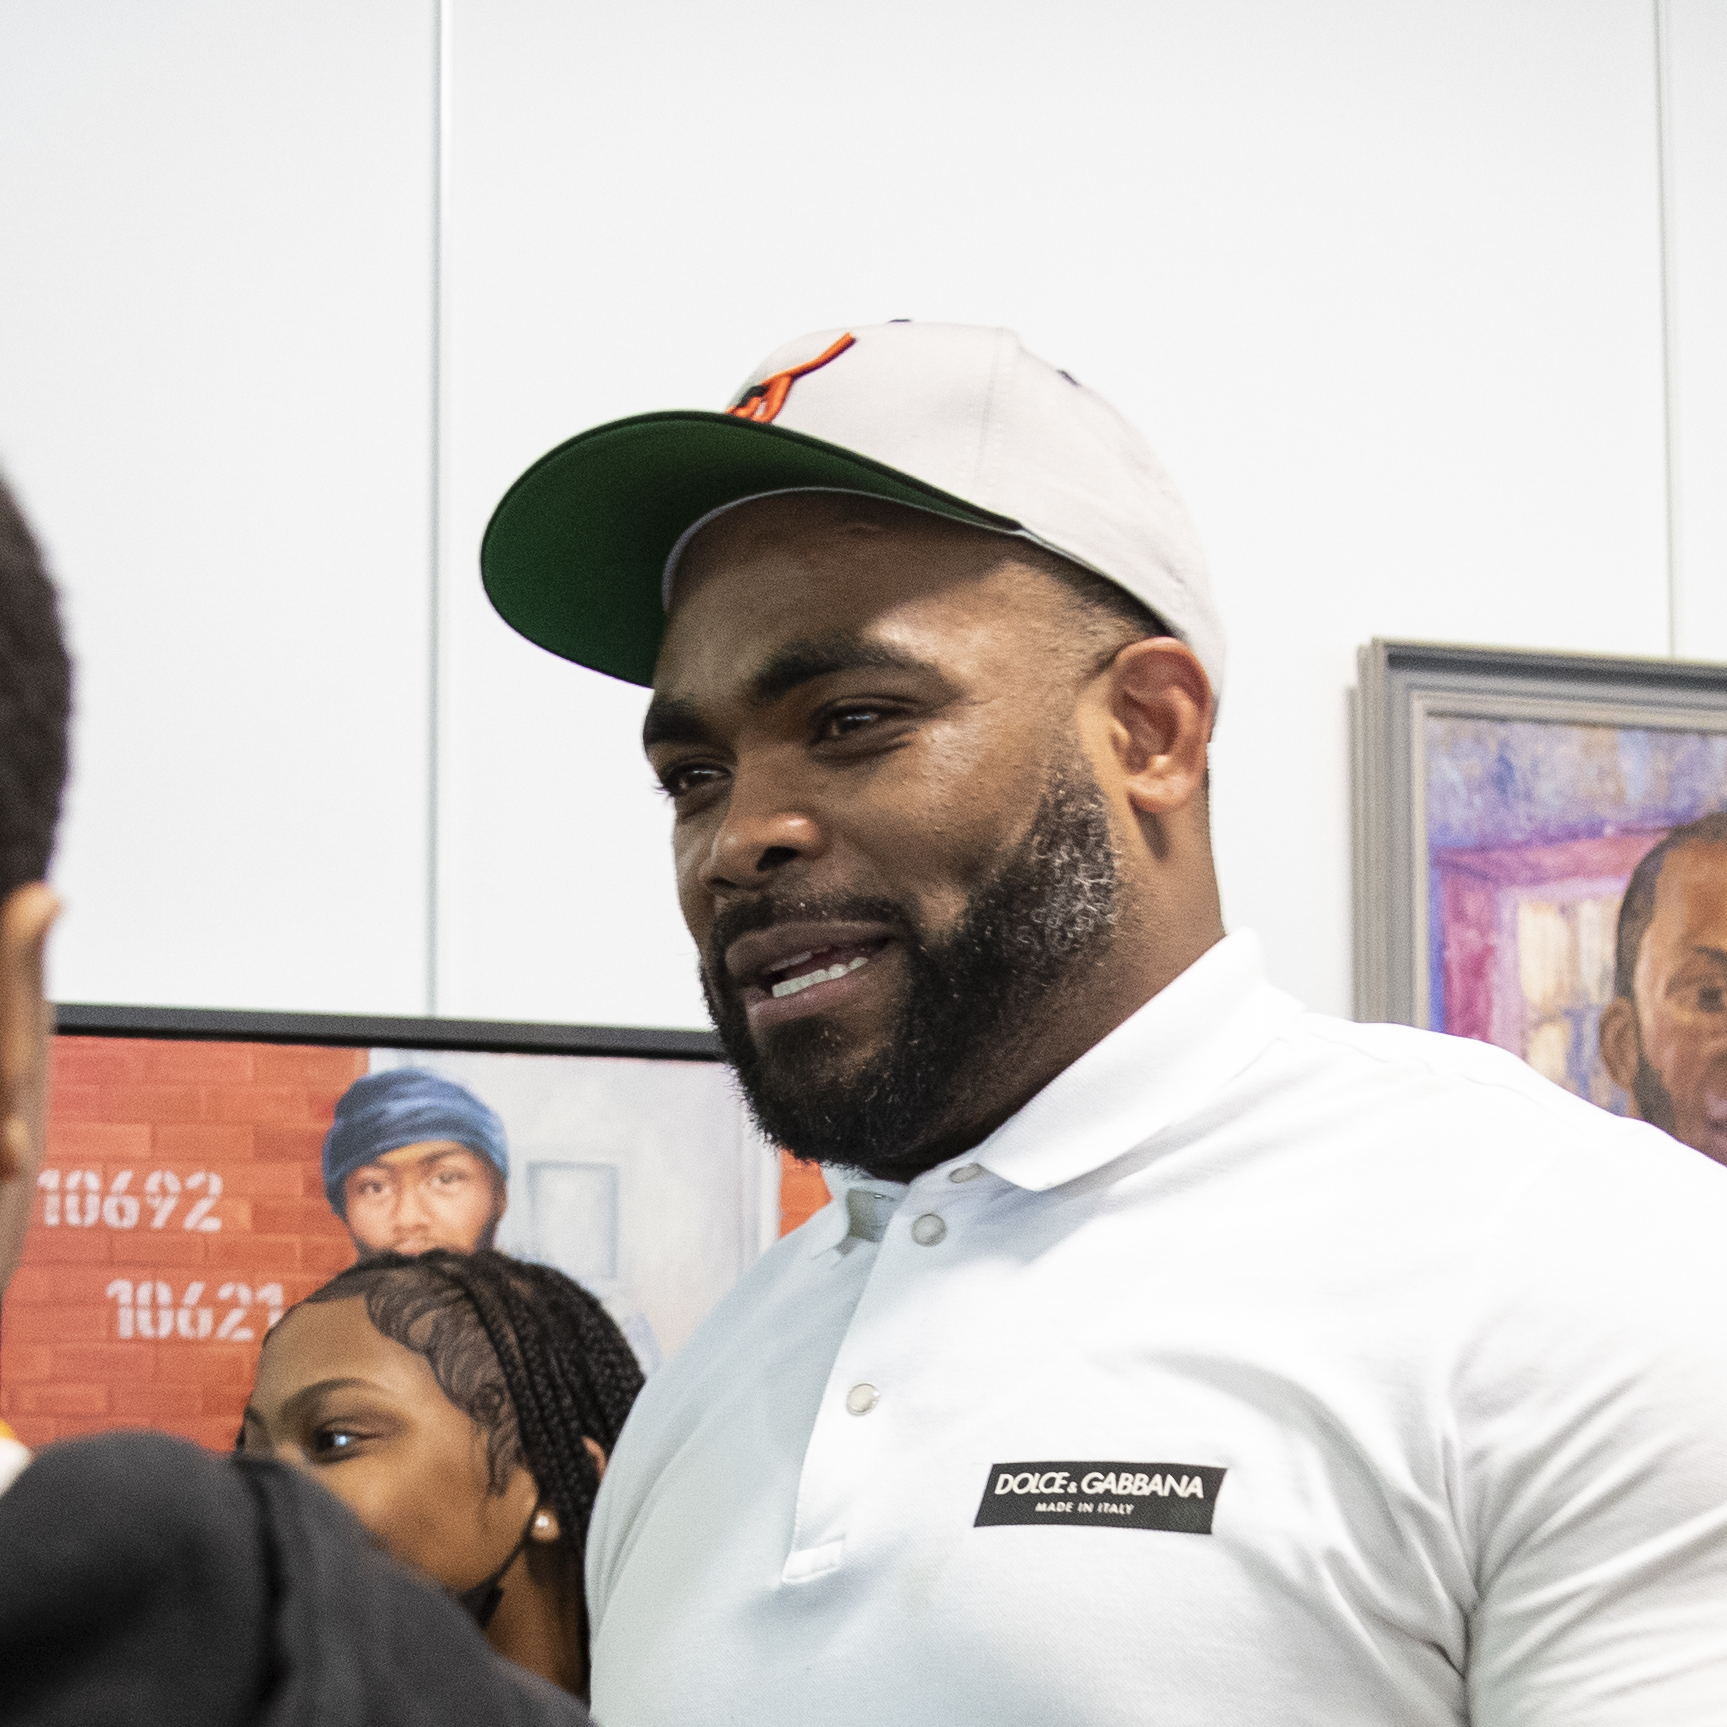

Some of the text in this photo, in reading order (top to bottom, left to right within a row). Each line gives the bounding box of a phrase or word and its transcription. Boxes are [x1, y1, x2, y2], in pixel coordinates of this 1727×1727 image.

[37, 1169, 222, 1232] 10692
[106, 1278, 284, 1341] 10621
[994, 1471, 1071, 1495] DOLCE
[1080, 1471, 1205, 1499] GABBANA
[1035, 1501, 1135, 1515] MADE IN ITALY
